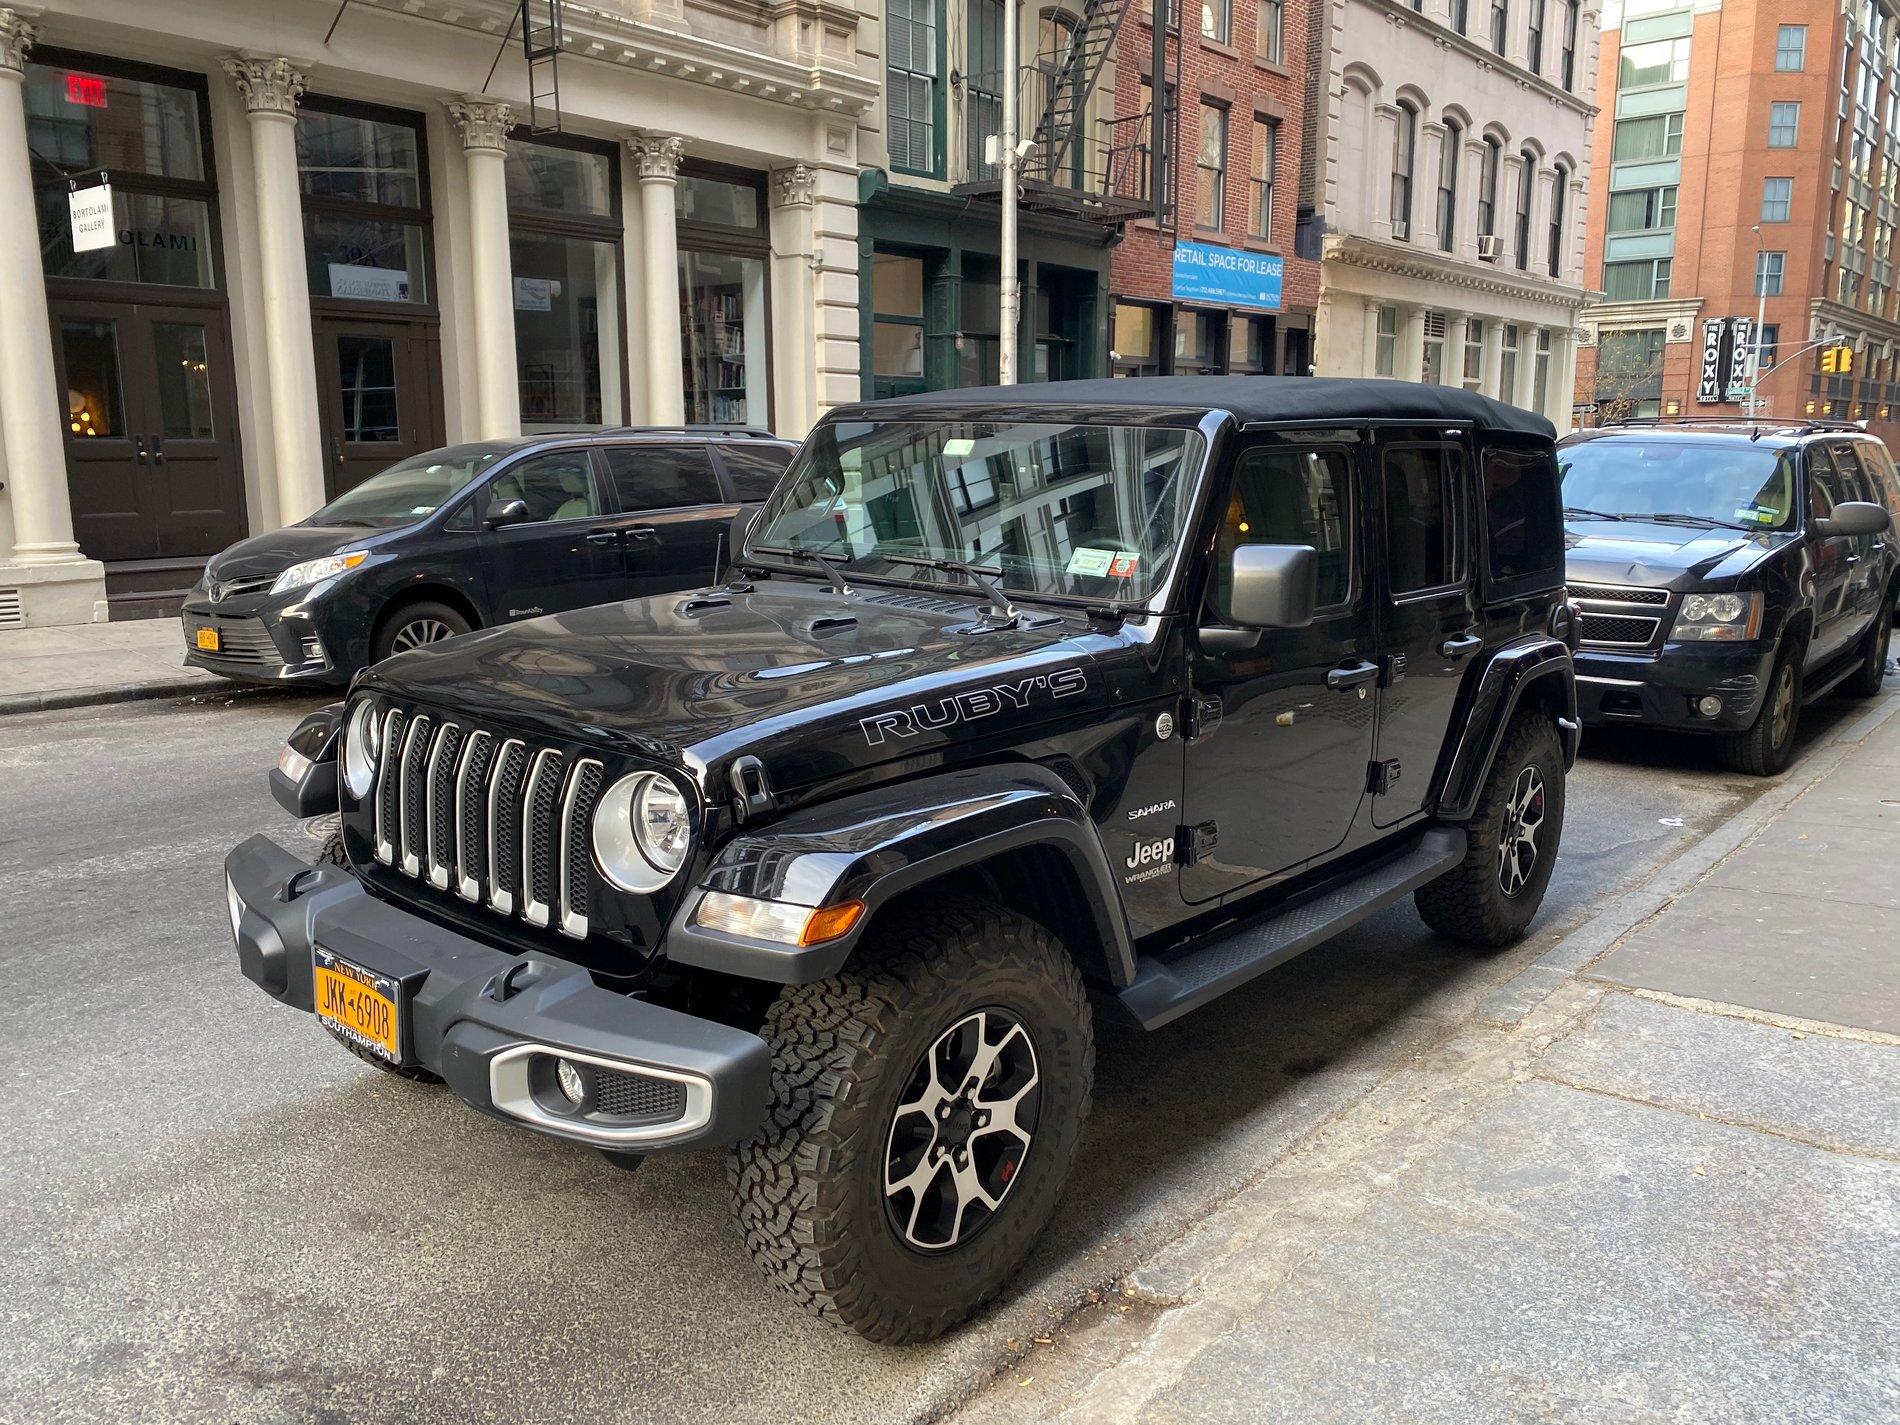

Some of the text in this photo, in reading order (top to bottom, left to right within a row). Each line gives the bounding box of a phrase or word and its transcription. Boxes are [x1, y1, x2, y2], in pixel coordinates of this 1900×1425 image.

[73, 204, 109, 219] BORTOLAMI
[78, 220, 105, 233] GALLERY
[118, 230, 197, 251] OLAMI
[1174, 248, 1282, 277] RETAIL SPACE FOR LEASE
[1703, 333, 1718, 394] ROXY
[859, 667, 1087, 746] RUBY'S
[1128, 800, 1176, 820] SAHARA
[1126, 837, 1175, 868] Jeep
[1125, 863, 1172, 884] WRANGLER
[334, 962, 354, 977] NEW
[321, 1016, 391, 1060] SOUTHAMPTON
